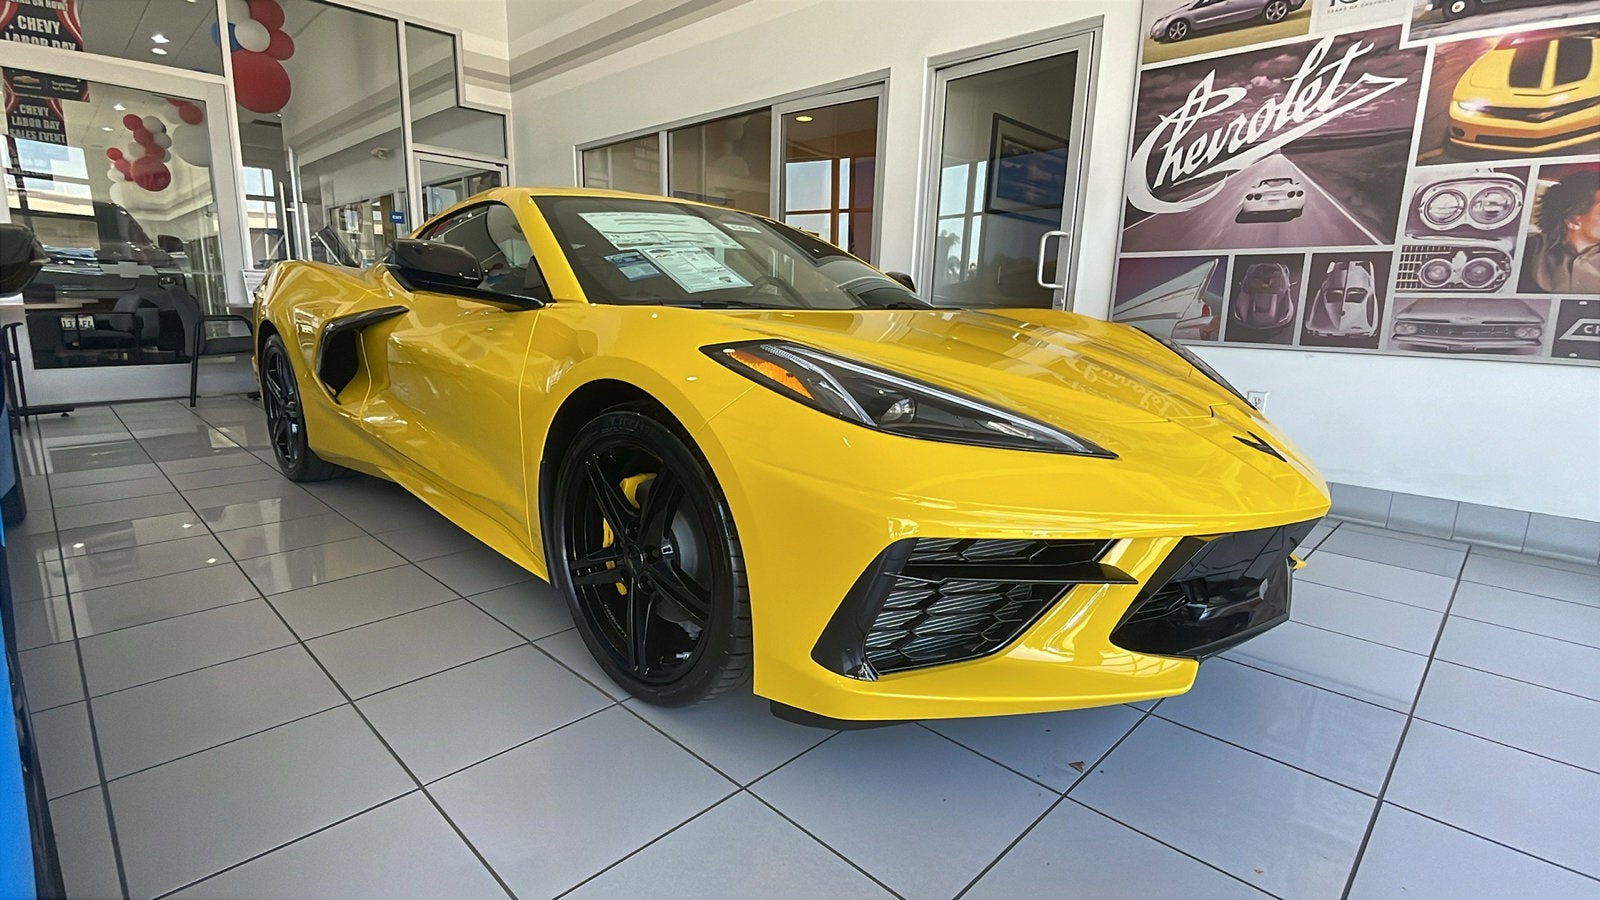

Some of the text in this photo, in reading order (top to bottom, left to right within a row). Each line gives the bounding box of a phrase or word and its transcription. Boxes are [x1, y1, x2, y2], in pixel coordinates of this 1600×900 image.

[17, 15, 60, 35] CHEVY
[19, 104, 49, 116] CHEVY
[11, 116, 60, 130] LABOR DAY
[1126, 35, 1408, 213] Chevrolet
[9, 128, 65, 143] SALES EVENT
